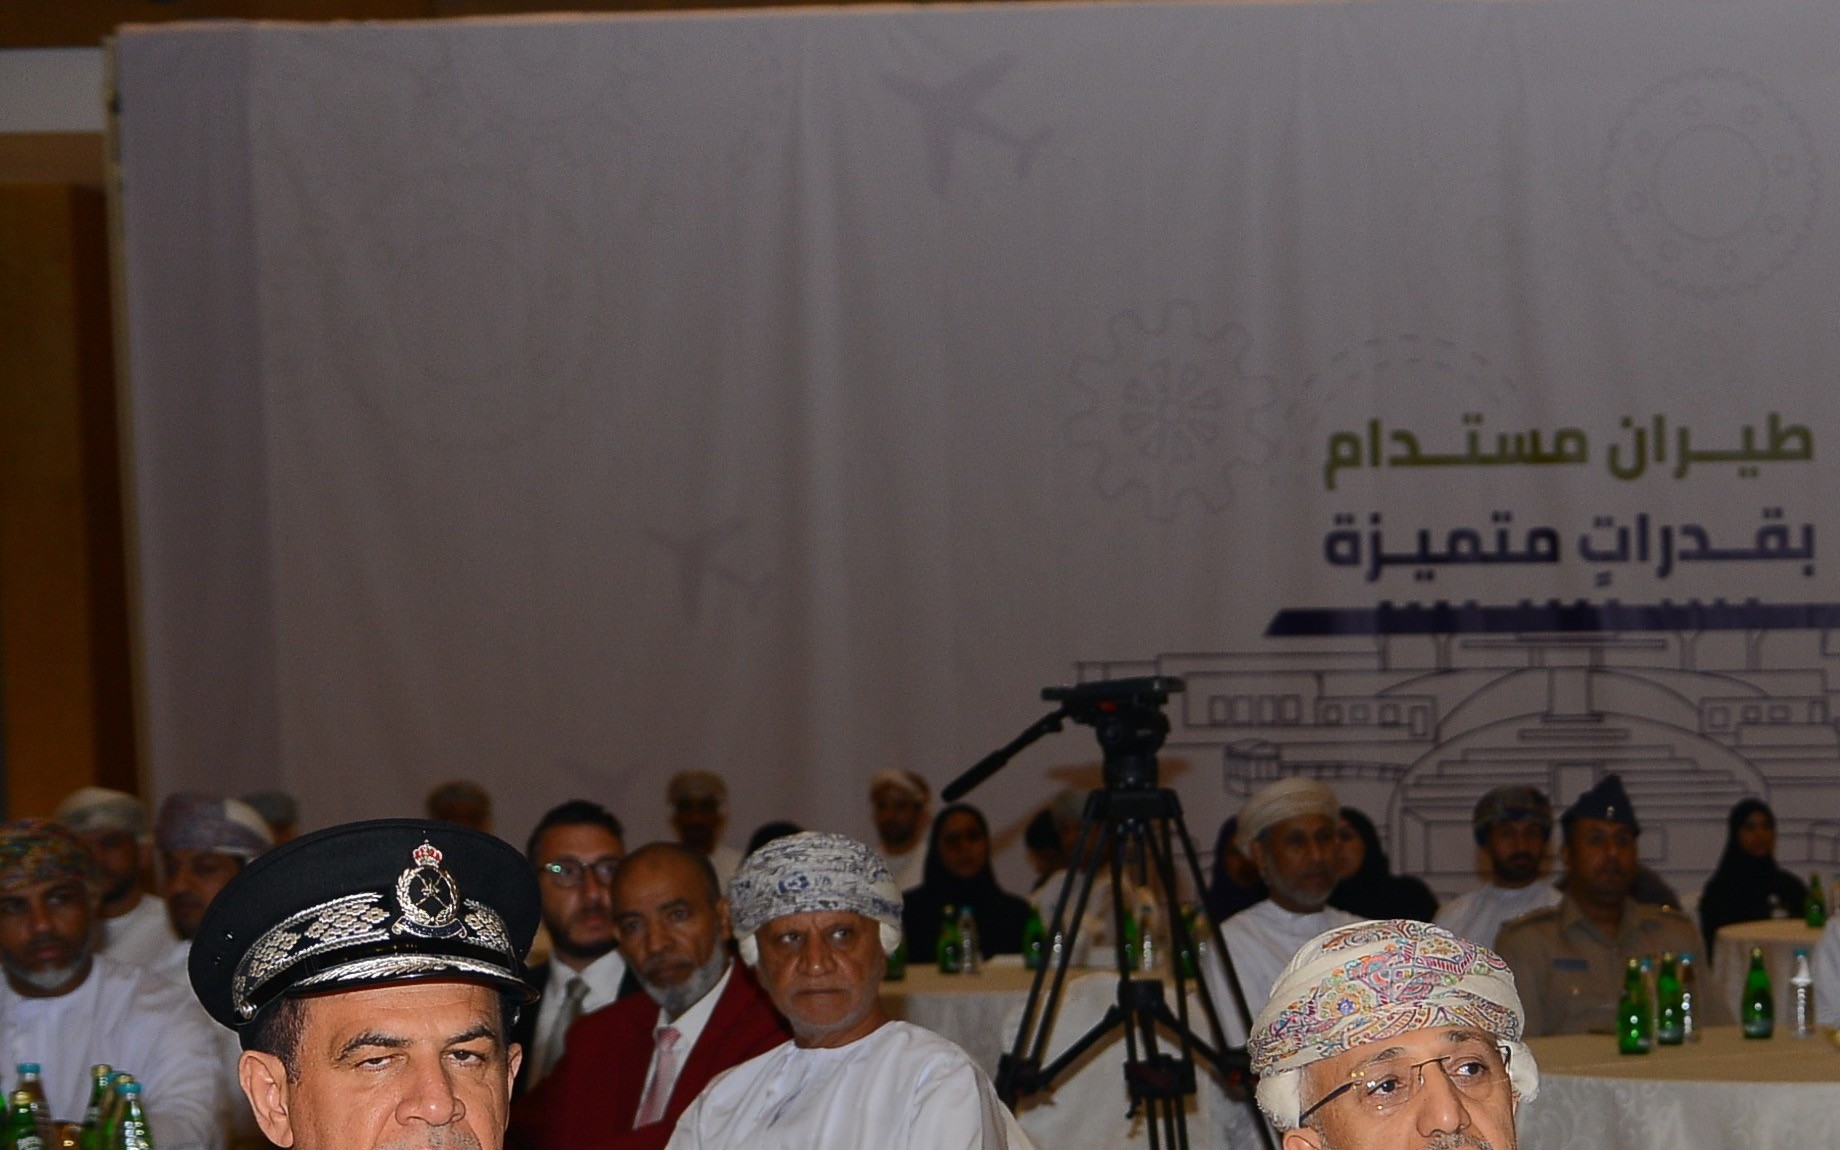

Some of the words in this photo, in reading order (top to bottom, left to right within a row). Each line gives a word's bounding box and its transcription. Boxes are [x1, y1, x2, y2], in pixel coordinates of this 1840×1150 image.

[1324, 413, 1589, 490] مستدام
[1608, 413, 1815, 480] طيران
[1323, 511, 1560, 583] متميزة
